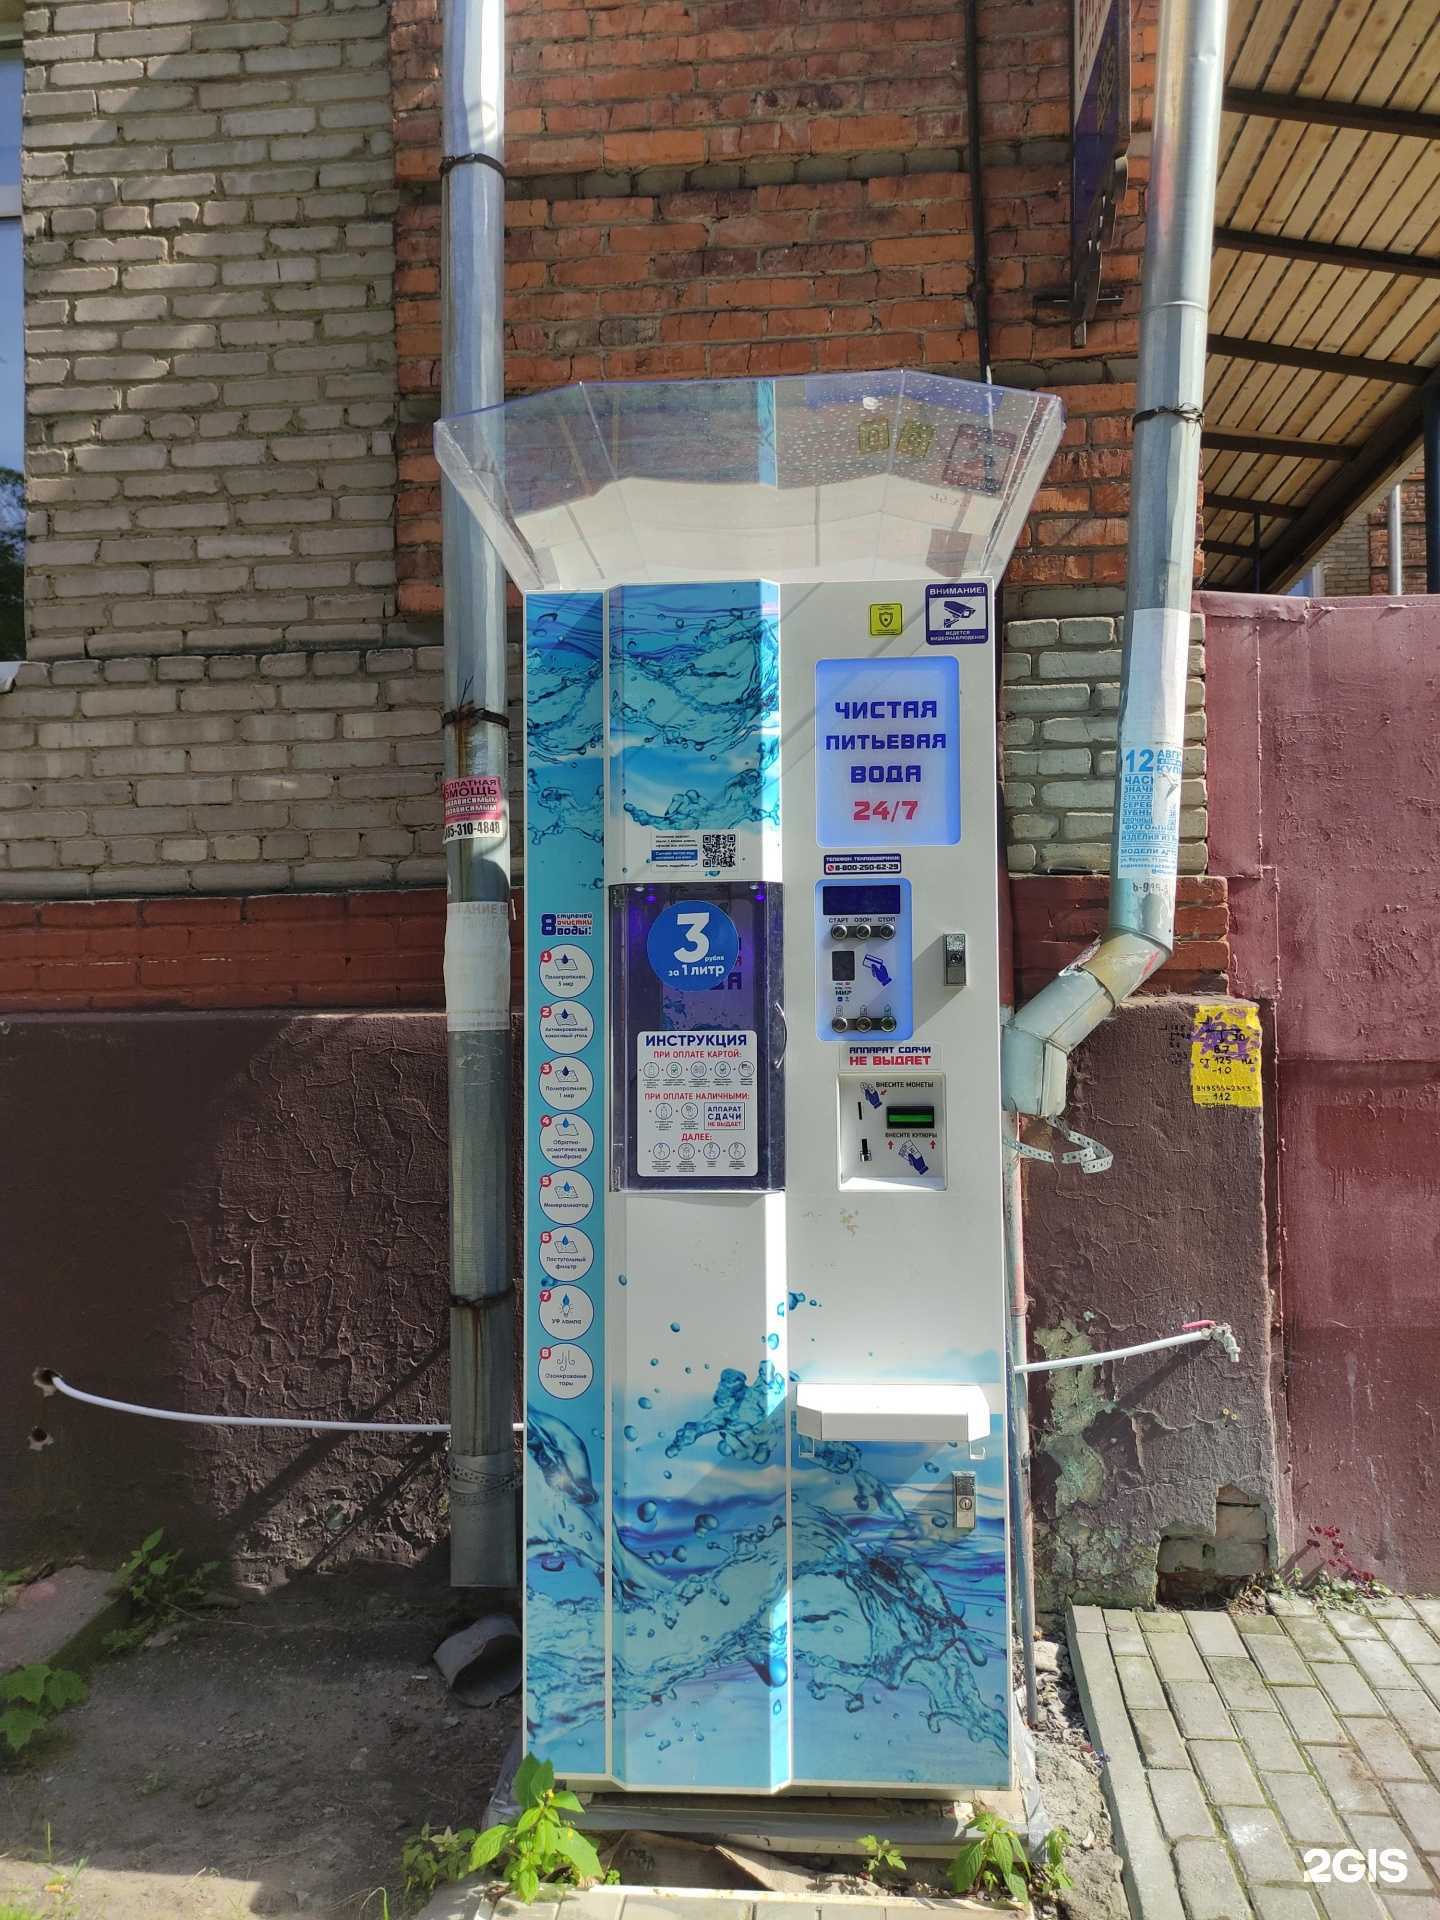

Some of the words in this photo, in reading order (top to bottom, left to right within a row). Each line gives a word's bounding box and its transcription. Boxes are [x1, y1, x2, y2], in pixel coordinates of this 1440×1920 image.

[930, 587, 985, 595] ВНИМАНИЕ!
[835, 701, 937, 719] ЧИСТАЯ
[826, 734, 946, 750] ПИТЬЕВАЯ
[1125, 748, 1154, 773] 12
[851, 765, 921, 783] ВОДА
[853, 800, 918, 822] 24/7
[542, 914, 556, 936] 8
[557, 926, 592, 936] воды:
[674, 912, 710, 963] 3
[682, 964, 688, 976] 1
[690, 965, 725, 976] литр
[542, 1008, 550, 1016] 2
[646, 1034, 747, 1047] ИНСТРУКЦИЯ
[708, 1049, 742, 1058] КАРТОЙ:
[849, 1046, 894, 1054] АППАРАТ
[898, 1046, 931, 1054] СДАЧИ
[849, 1056, 867, 1066] НЕ
[873, 1056, 931, 1065] ВЫДАЕТ
[543, 1065, 550, 1073] 3
[696, 1092, 750, 1100] НАЛИЧНЫМИ:
[543, 1117, 551, 1125] 4
[682, 1133, 712, 1141] ДАЛЕЕ:
[542, 1292, 549, 1300] 7
